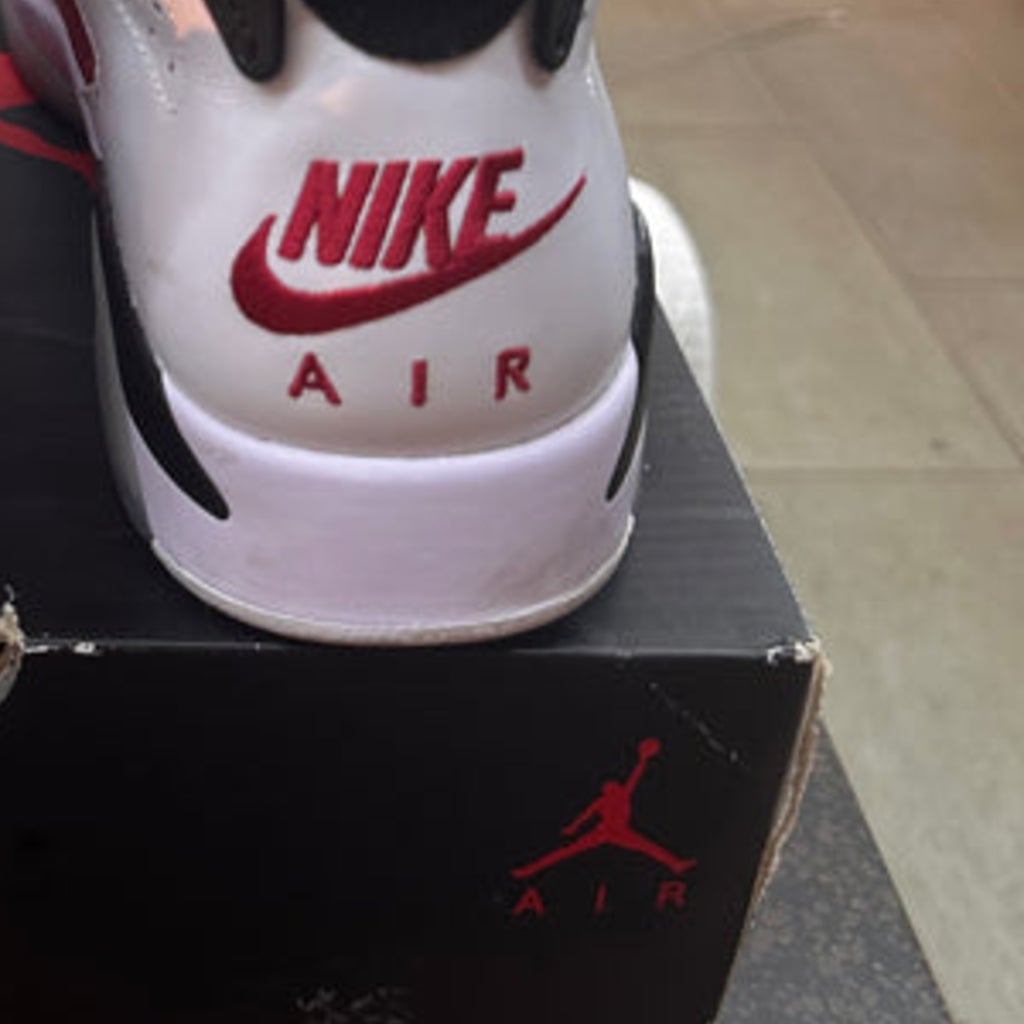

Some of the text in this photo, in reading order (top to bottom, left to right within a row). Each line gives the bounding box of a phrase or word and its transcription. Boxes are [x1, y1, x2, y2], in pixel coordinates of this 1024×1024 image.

[277, 146, 525, 272] NIKE
[287, 346, 532, 408] AIR
[511, 880, 687, 917] AIR
